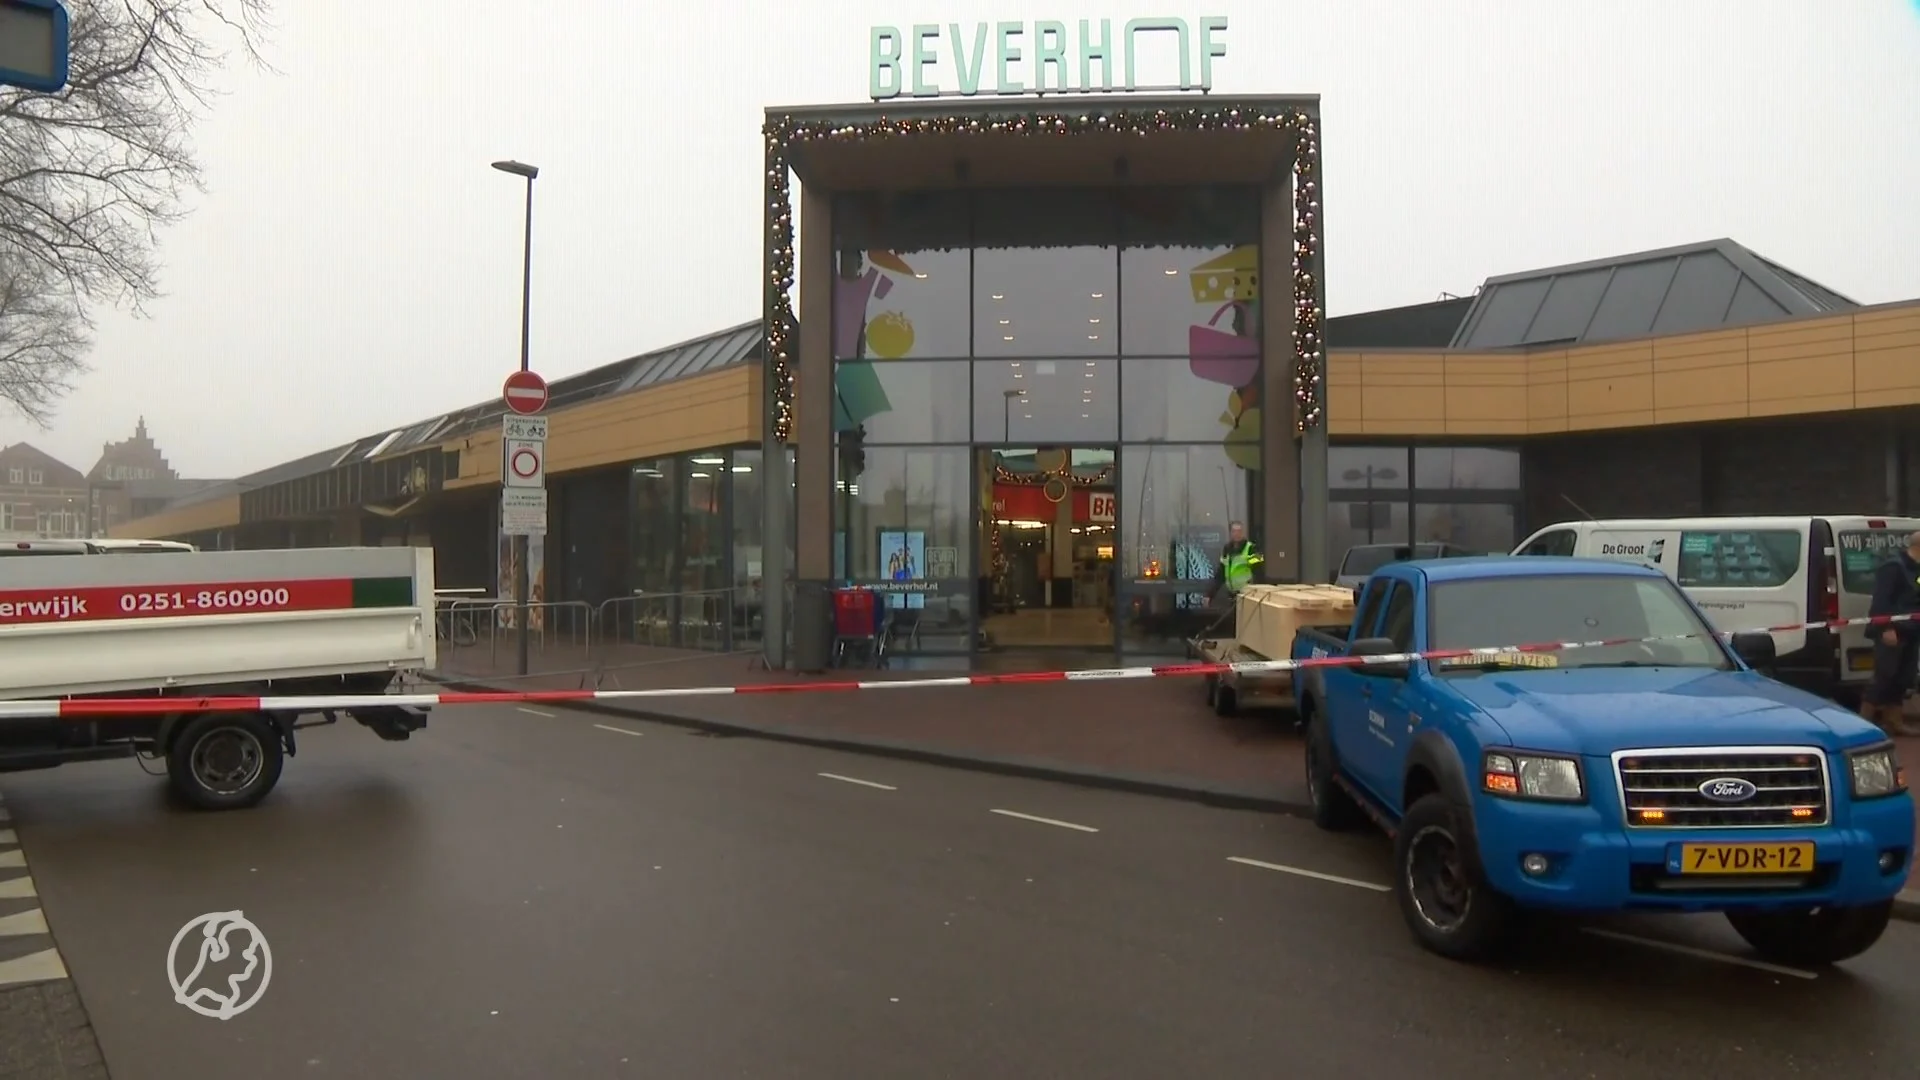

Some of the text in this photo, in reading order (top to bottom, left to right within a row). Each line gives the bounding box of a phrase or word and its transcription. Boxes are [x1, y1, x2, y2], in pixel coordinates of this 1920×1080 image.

[870, 16, 1228, 99] BEVERHOF
[1602, 543, 1645, 554] De Groot
[1841, 534, 1862, 551] Wij
[1865, 534, 1886, 551] zijn
[120, 588, 290, 612] 0251-860900
[1712, 782, 1744, 796] Ford
[1693, 847, 1802, 869] 7-VDR-12
